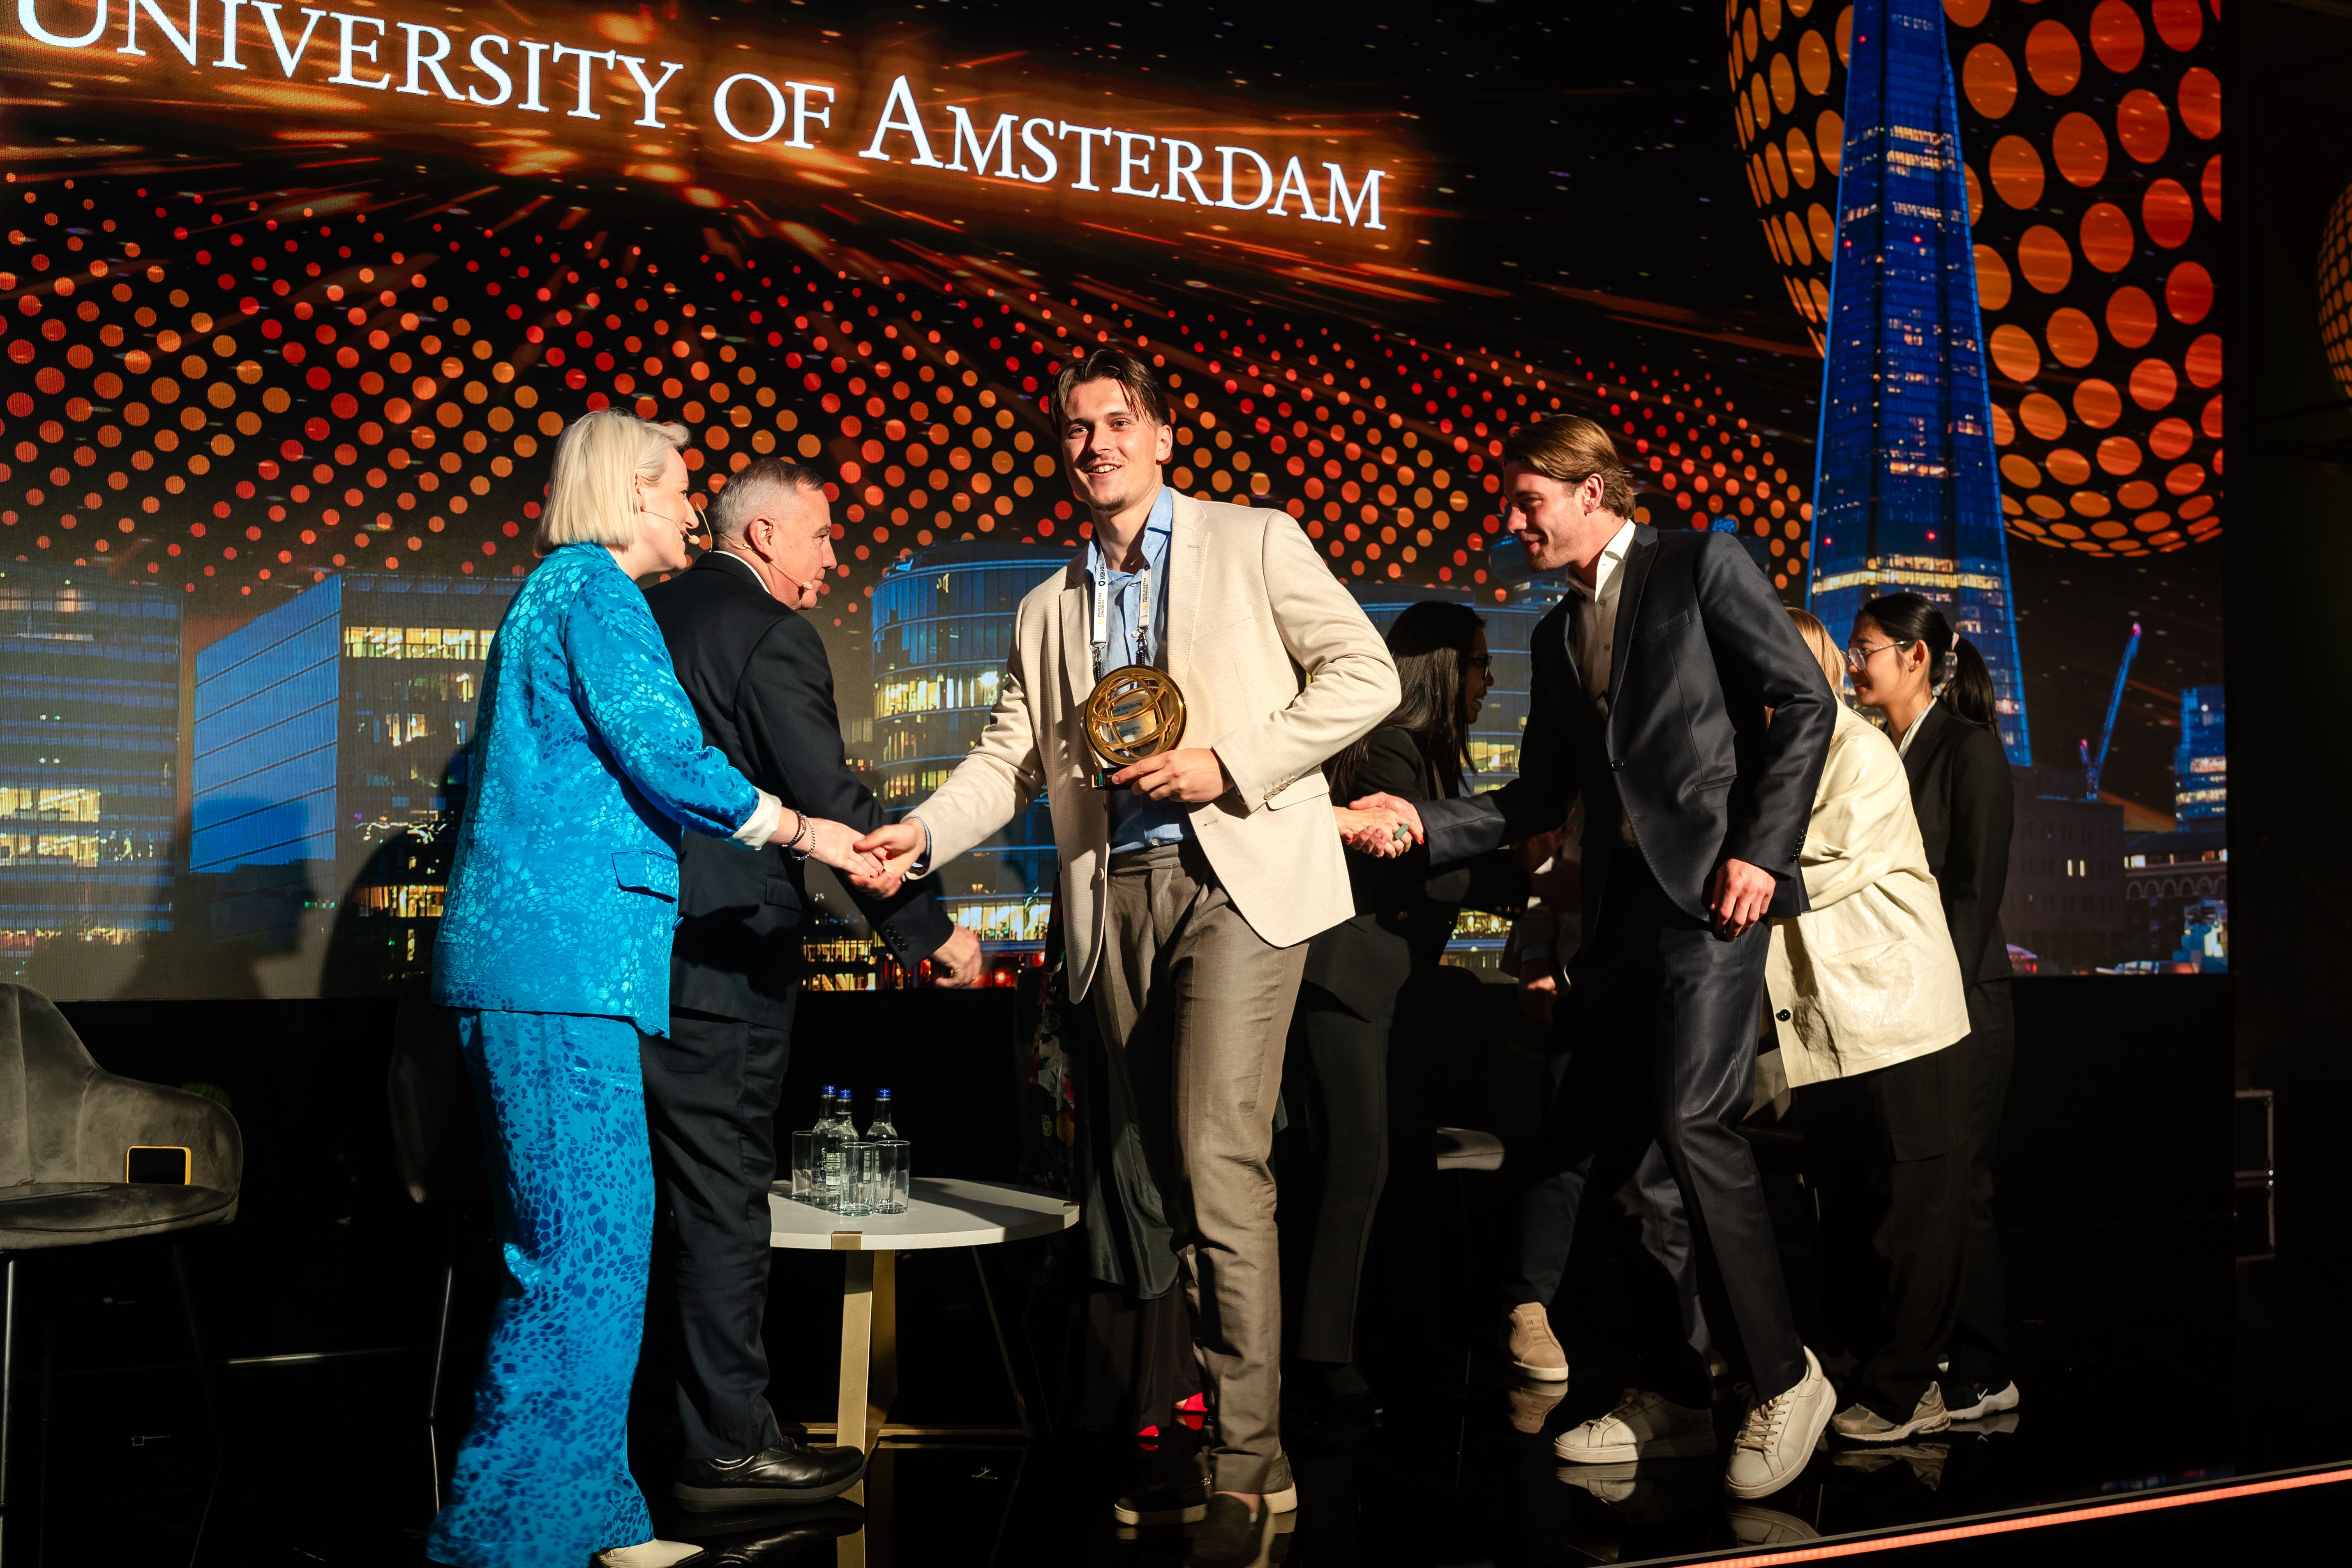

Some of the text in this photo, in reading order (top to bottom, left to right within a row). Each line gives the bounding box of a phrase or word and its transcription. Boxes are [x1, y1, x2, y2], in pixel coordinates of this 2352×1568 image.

[18, 0, 1386, 230] UNIVERSITY OF AMSTERDAM
